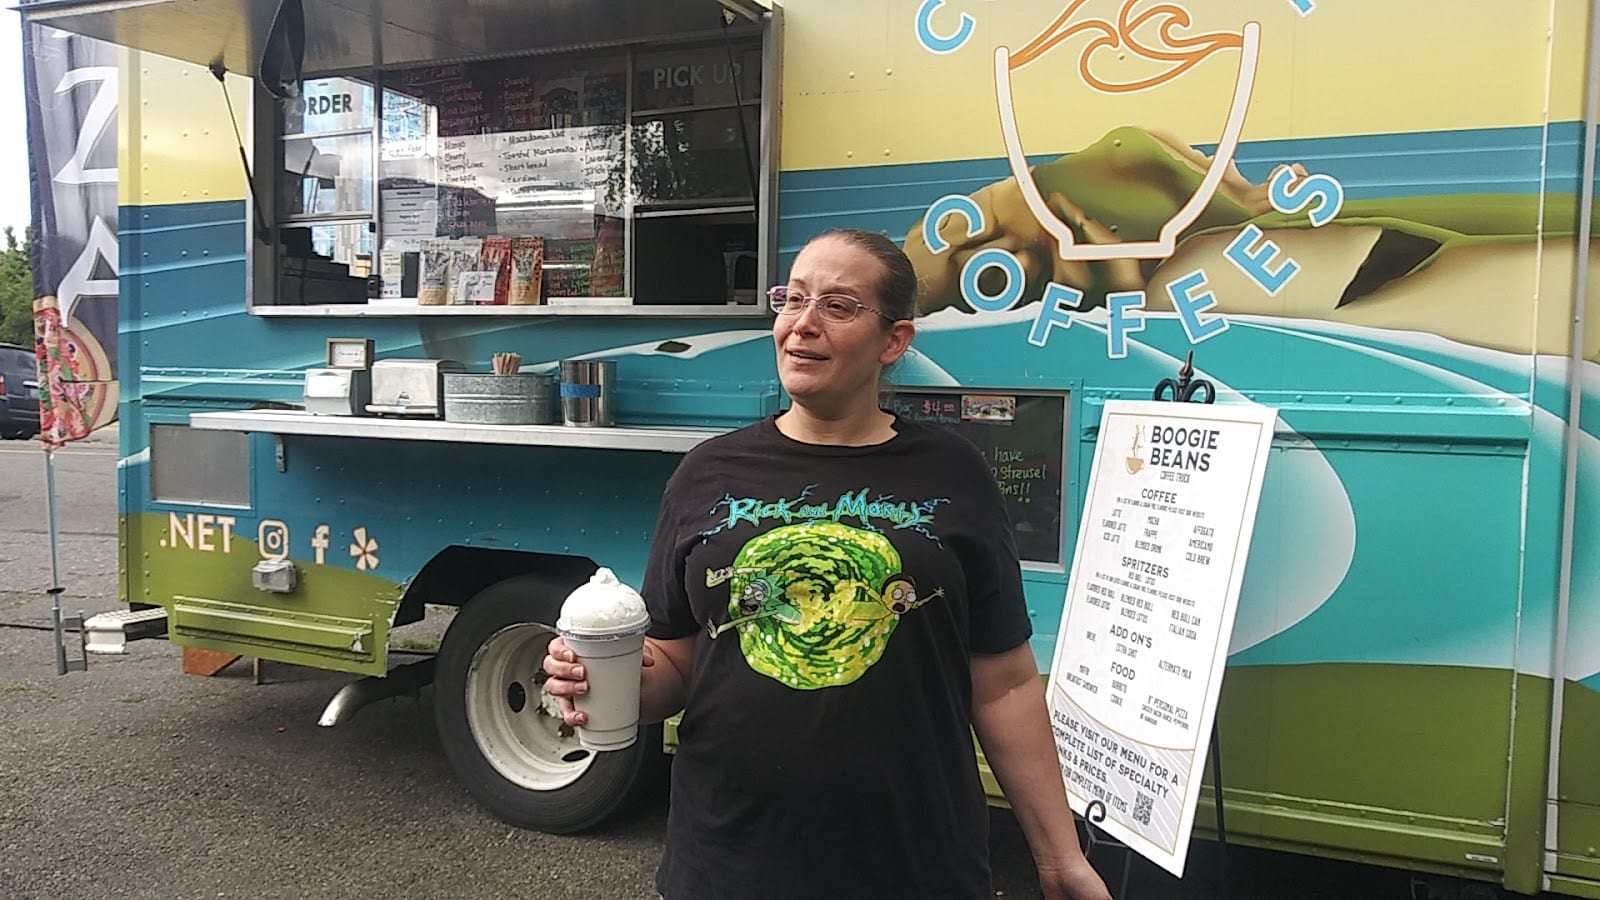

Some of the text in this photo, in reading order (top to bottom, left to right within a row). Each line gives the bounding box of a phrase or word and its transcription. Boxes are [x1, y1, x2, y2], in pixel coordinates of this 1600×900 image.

[653, 63, 743, 89] PICK UP
[444, 141, 466, 150] Mango
[922, 165, 1344, 359] COFFEES
[1150, 425, 1220, 450] BOOGIE
[994, 446, 1024, 462] have
[1149, 447, 1211, 472] BEANS
[1000, 463, 1047, 480] Streusel
[1141, 488, 1177, 504] COFFEE
[728, 497, 793, 530] Rick
[160, 512, 236, 554] .NET
[1121, 556, 1169, 579] SPRITZERS
[1109, 623, 1153, 649] ADD ON'S
[1110, 660, 1135, 681] FOOD
[1053, 710, 1179, 786] PLEASE VISIT OUR MENU FOR A
[1073, 754, 1078, 767] &
[1086, 746, 1103, 763] LIST
[1105, 756, 1117, 770] OF
[1118, 764, 1169, 799] SPECIALTY
